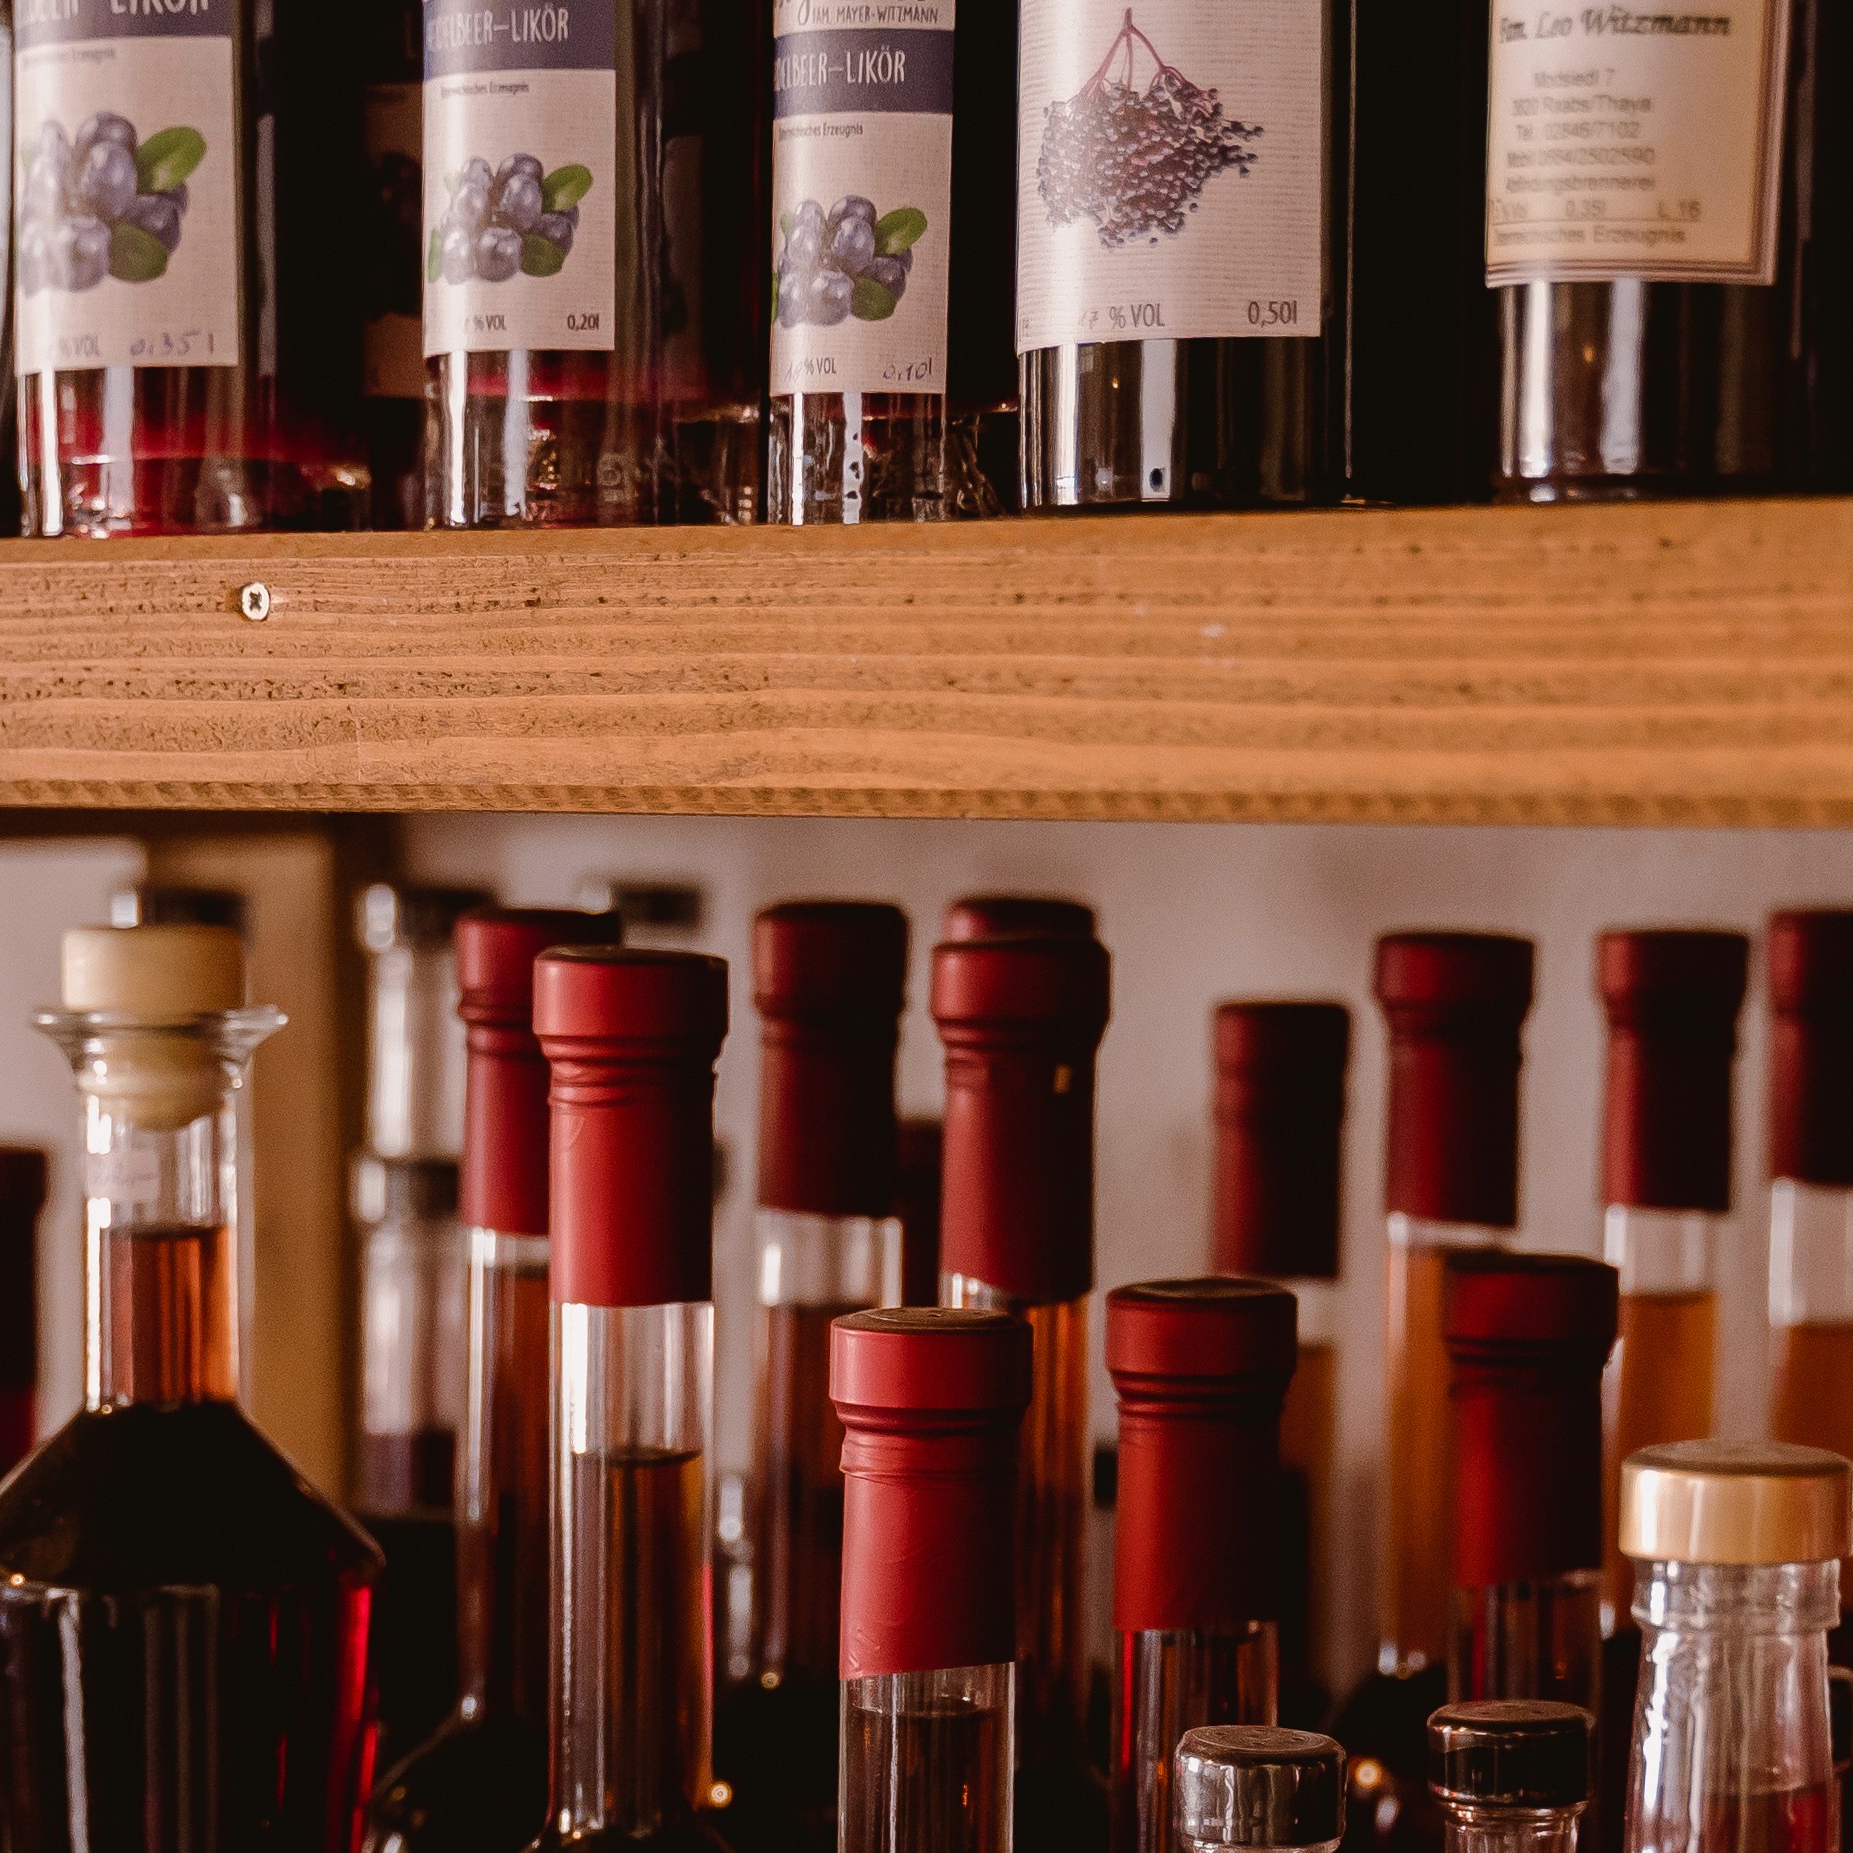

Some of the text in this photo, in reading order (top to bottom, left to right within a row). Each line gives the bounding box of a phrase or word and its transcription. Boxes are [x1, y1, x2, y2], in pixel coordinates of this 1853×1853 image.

[1581, 4, 1730, 37] Witzmann
[1109, 305, 1125, 329] %
[1131, 303, 1165, 328] VOL
[1248, 301, 1297, 328] 0,50l
[816, 358, 837, 374] VOL
